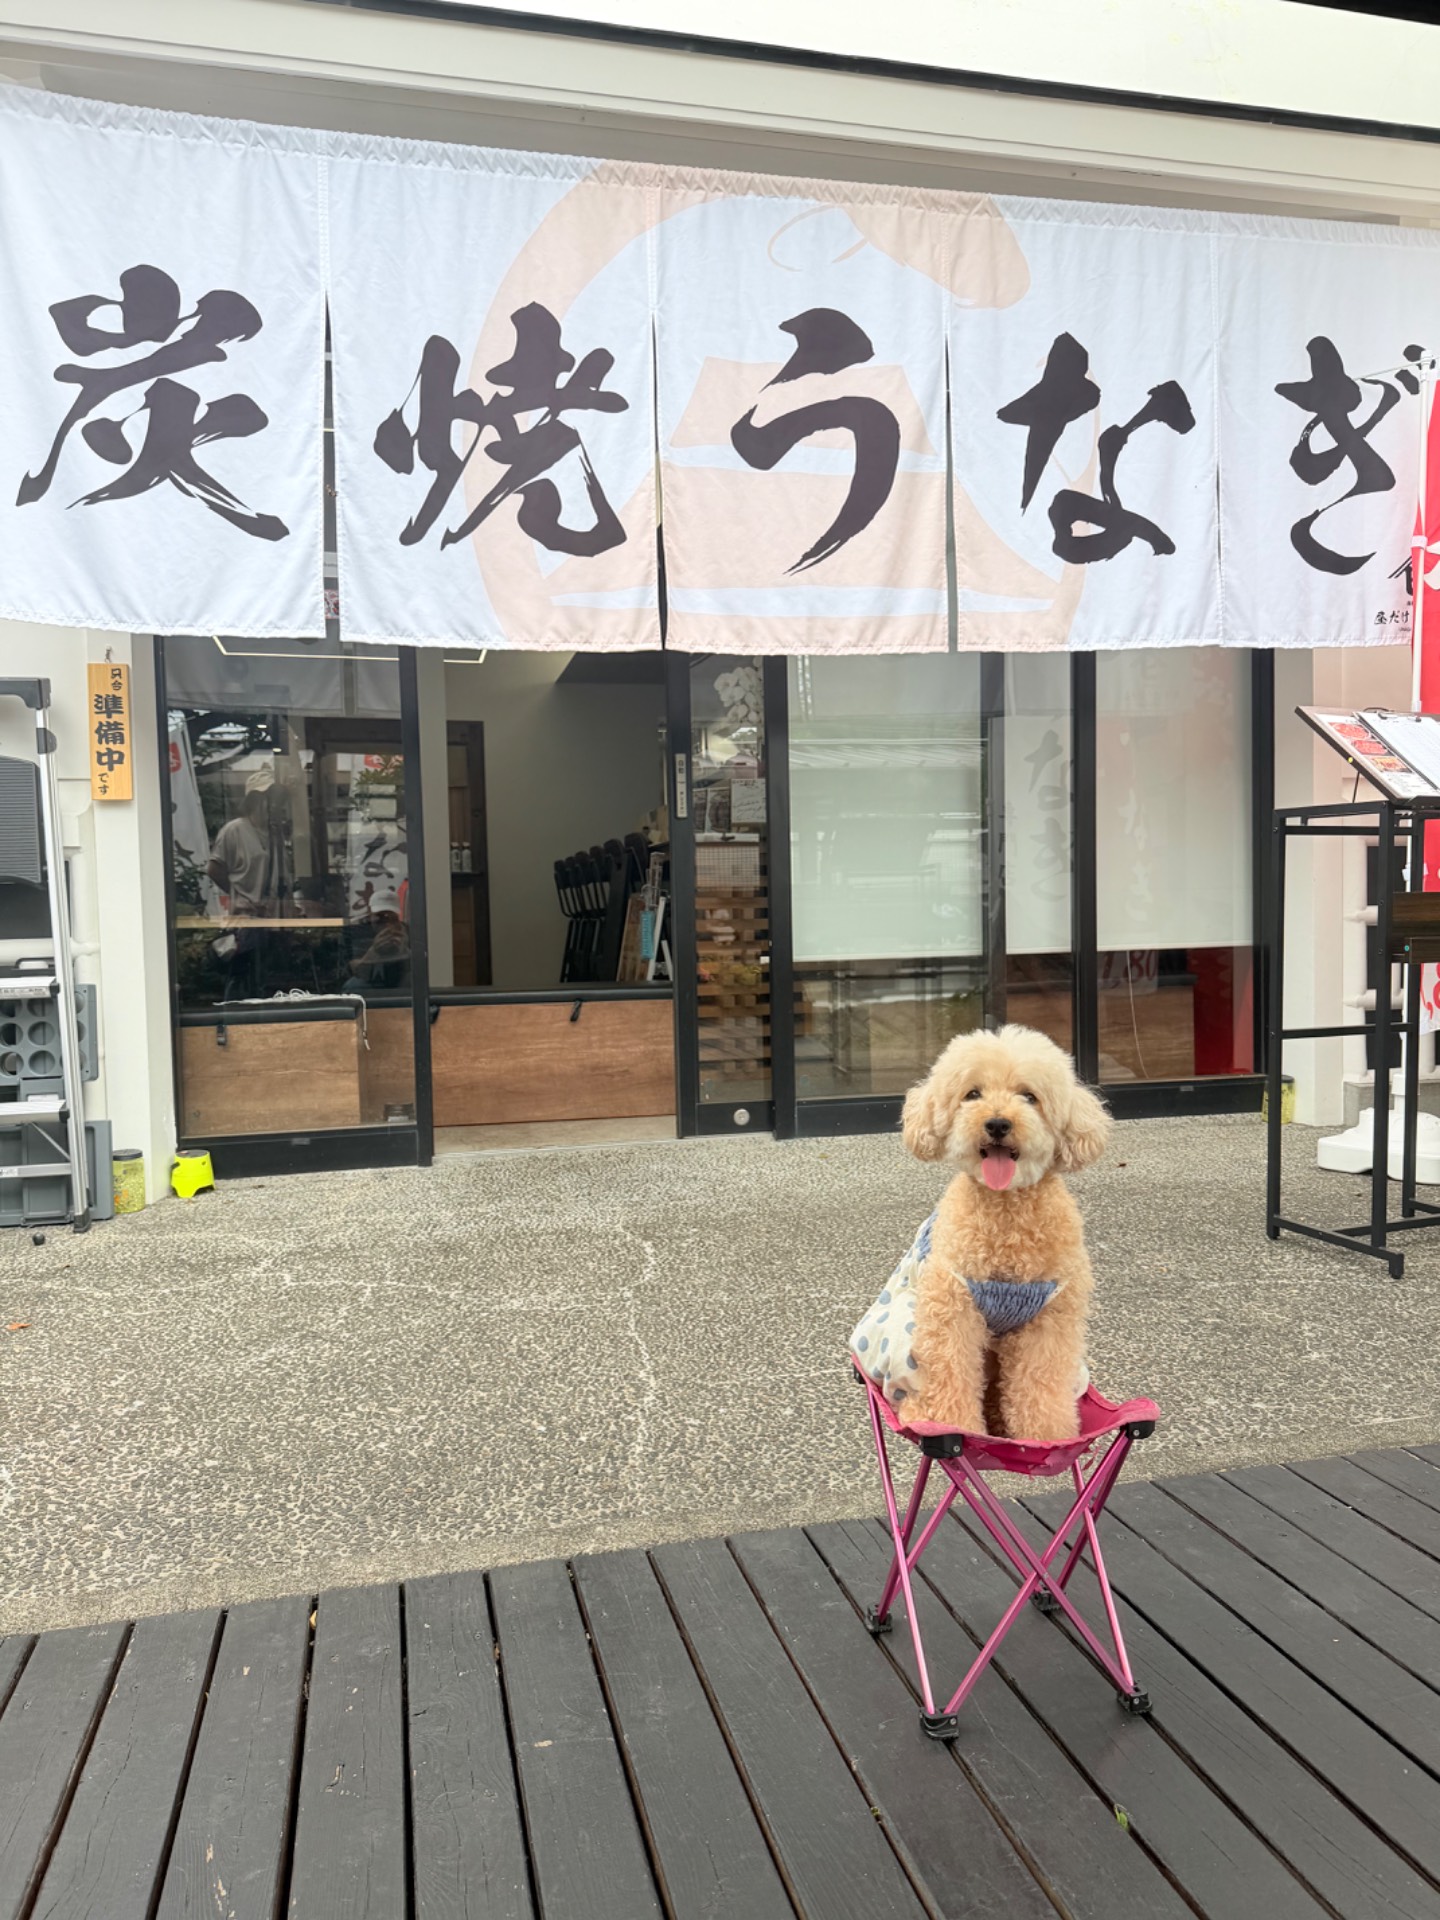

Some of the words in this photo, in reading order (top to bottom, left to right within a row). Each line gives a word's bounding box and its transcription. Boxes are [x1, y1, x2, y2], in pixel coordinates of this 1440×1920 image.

[16, 265, 1435, 575] 炭焼うなぎ
